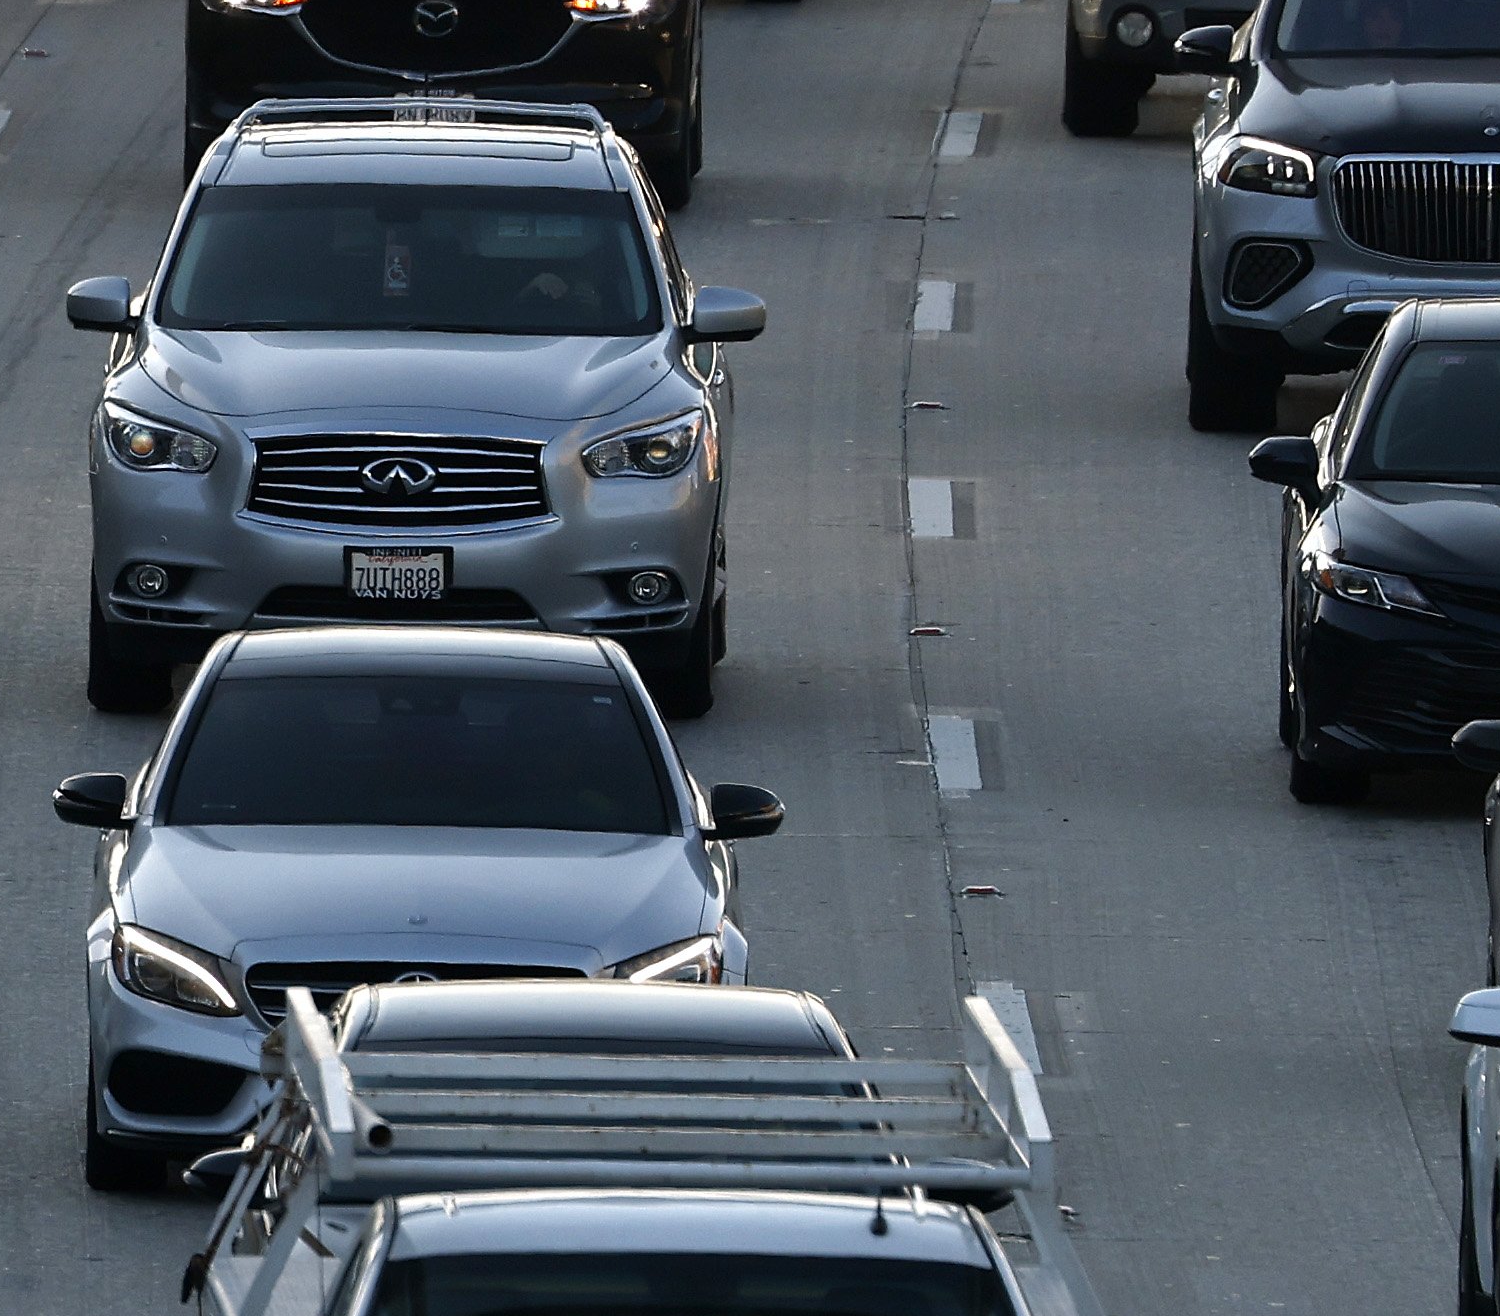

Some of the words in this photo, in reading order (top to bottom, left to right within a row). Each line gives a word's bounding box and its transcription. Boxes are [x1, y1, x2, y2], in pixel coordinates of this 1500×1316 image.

[355, 567, 440, 591] 7UTH888
[355, 589, 388, 599] VAN
[393, 589, 442, 601] NUYS
